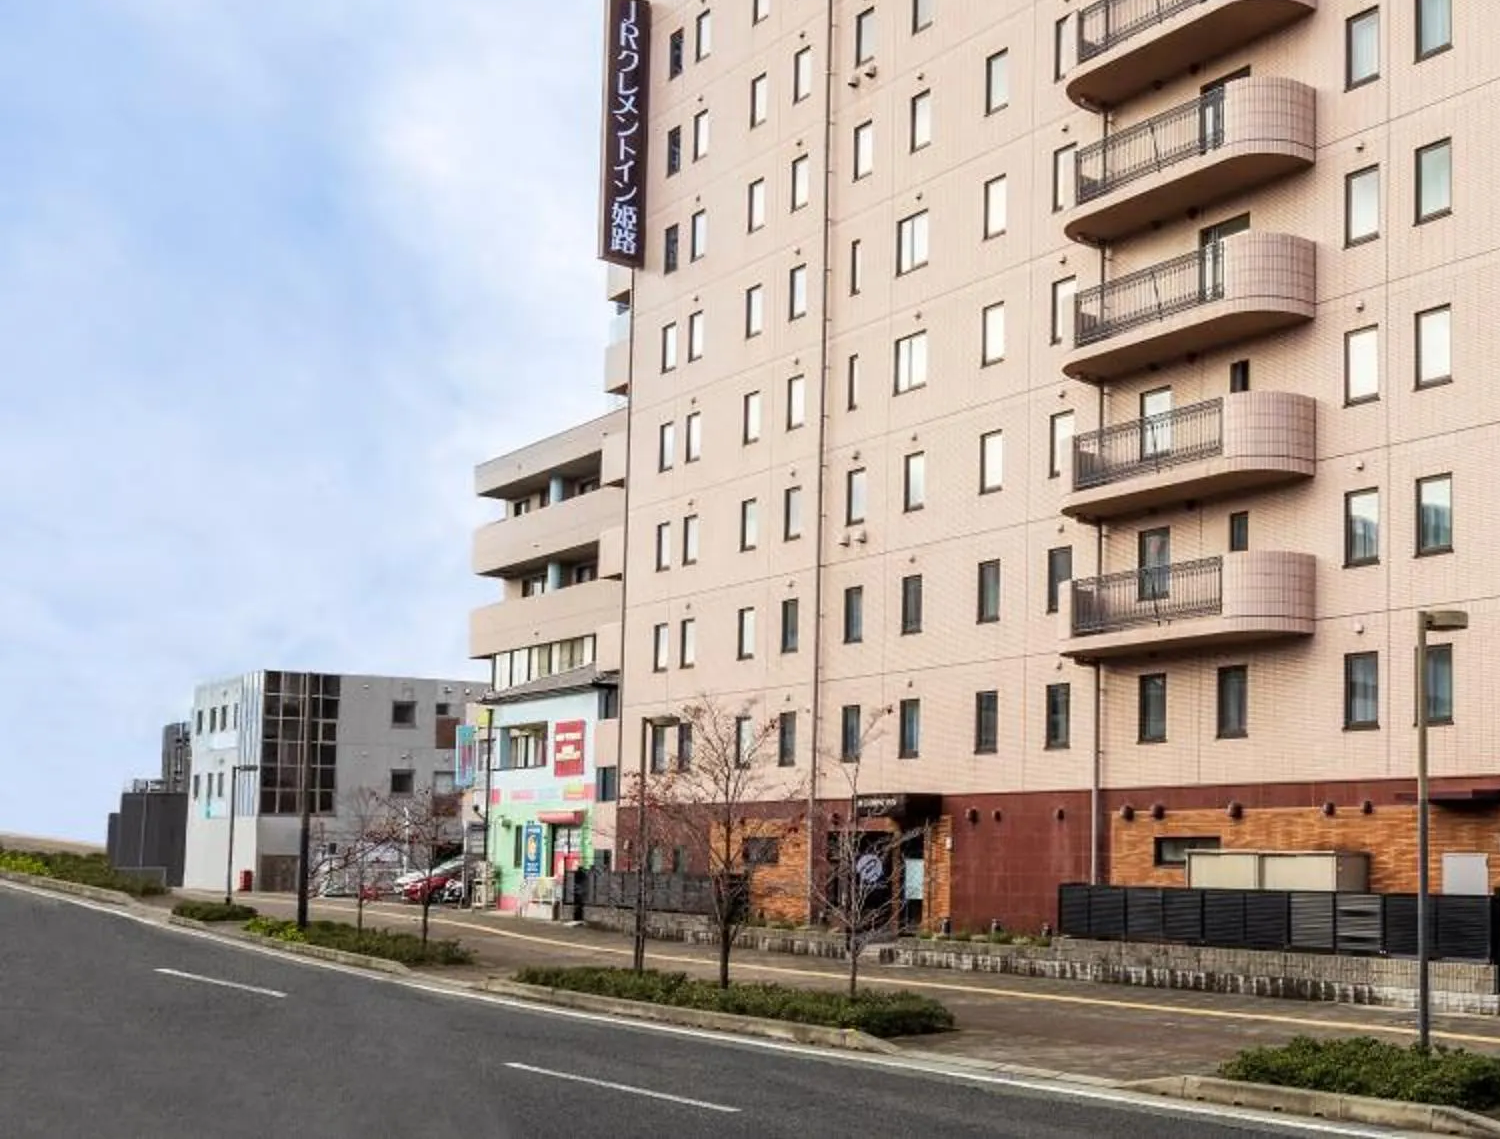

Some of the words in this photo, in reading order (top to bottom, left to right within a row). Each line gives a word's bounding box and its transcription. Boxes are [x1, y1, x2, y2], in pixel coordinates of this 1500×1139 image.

[611, 0, 640, 255] JRクレメントイン姫路
